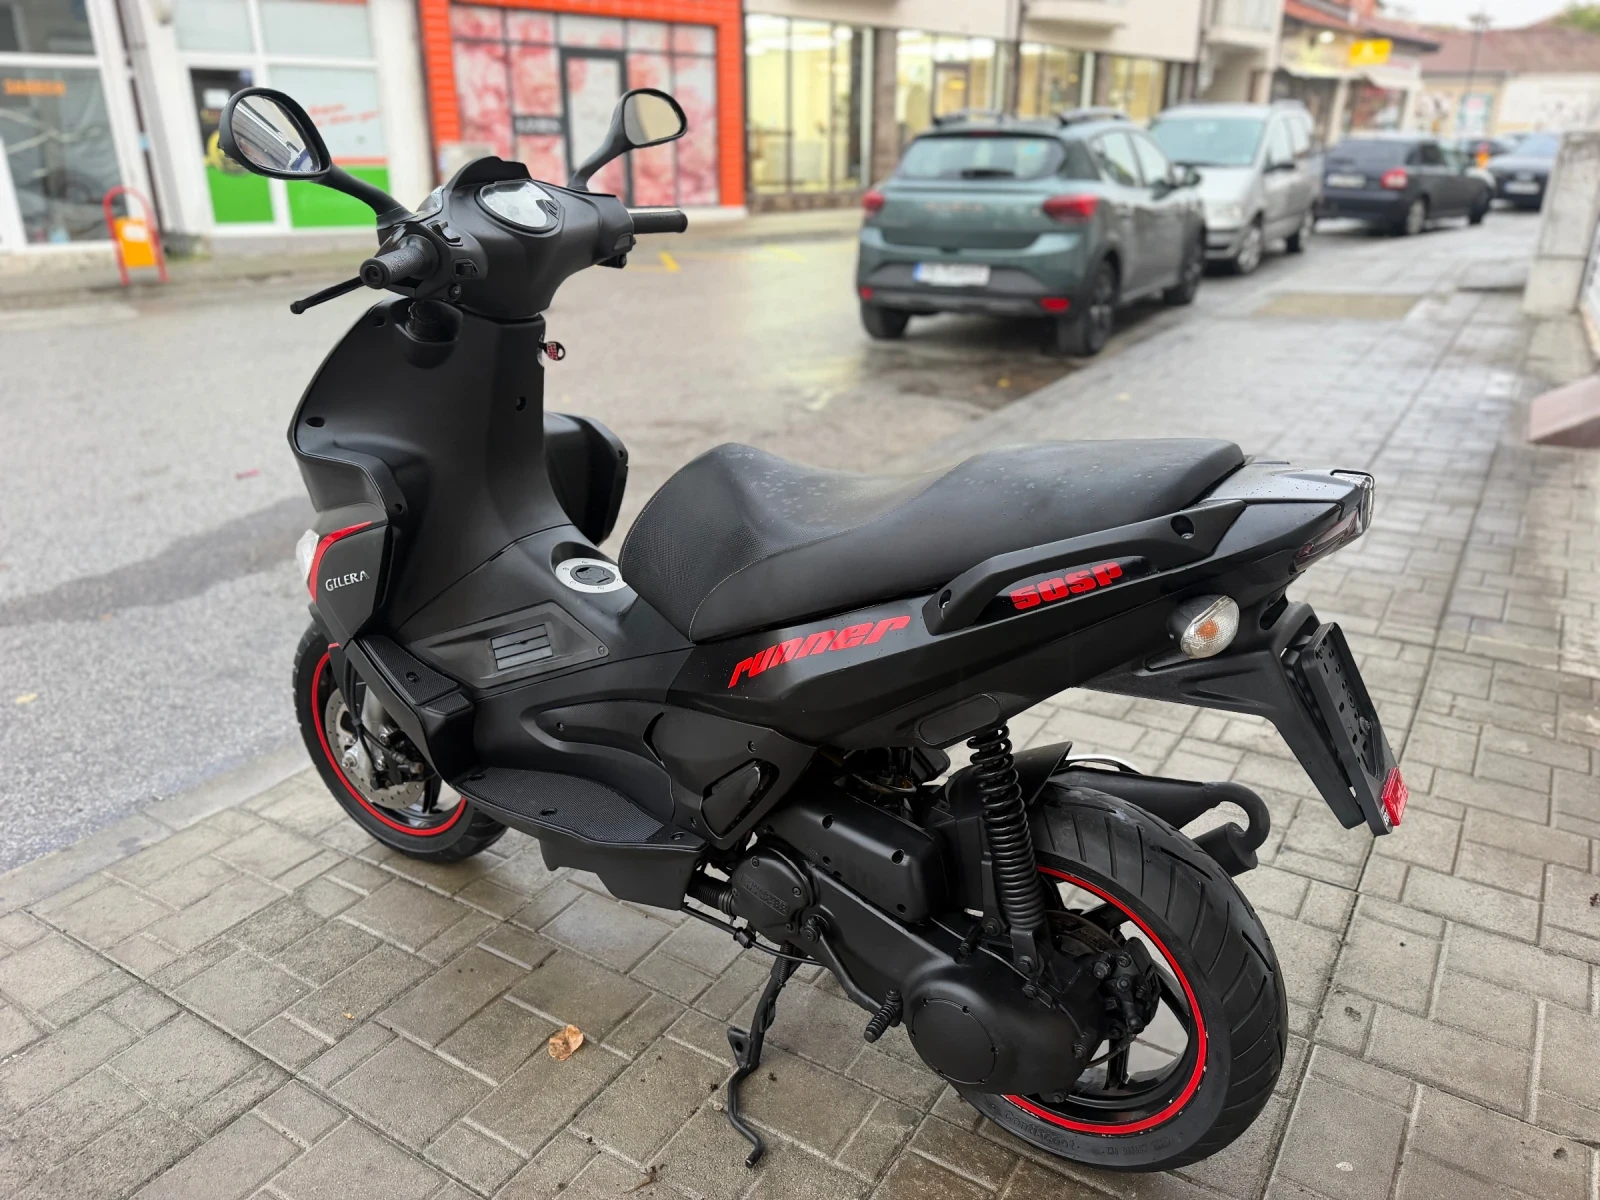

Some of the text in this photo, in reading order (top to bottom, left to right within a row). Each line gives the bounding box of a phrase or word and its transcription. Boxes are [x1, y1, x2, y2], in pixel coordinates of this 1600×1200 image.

[325, 570, 370, 592] GILERA
[1009, 561, 1123, 610] 50SP
[727, 615, 911, 689] runner
